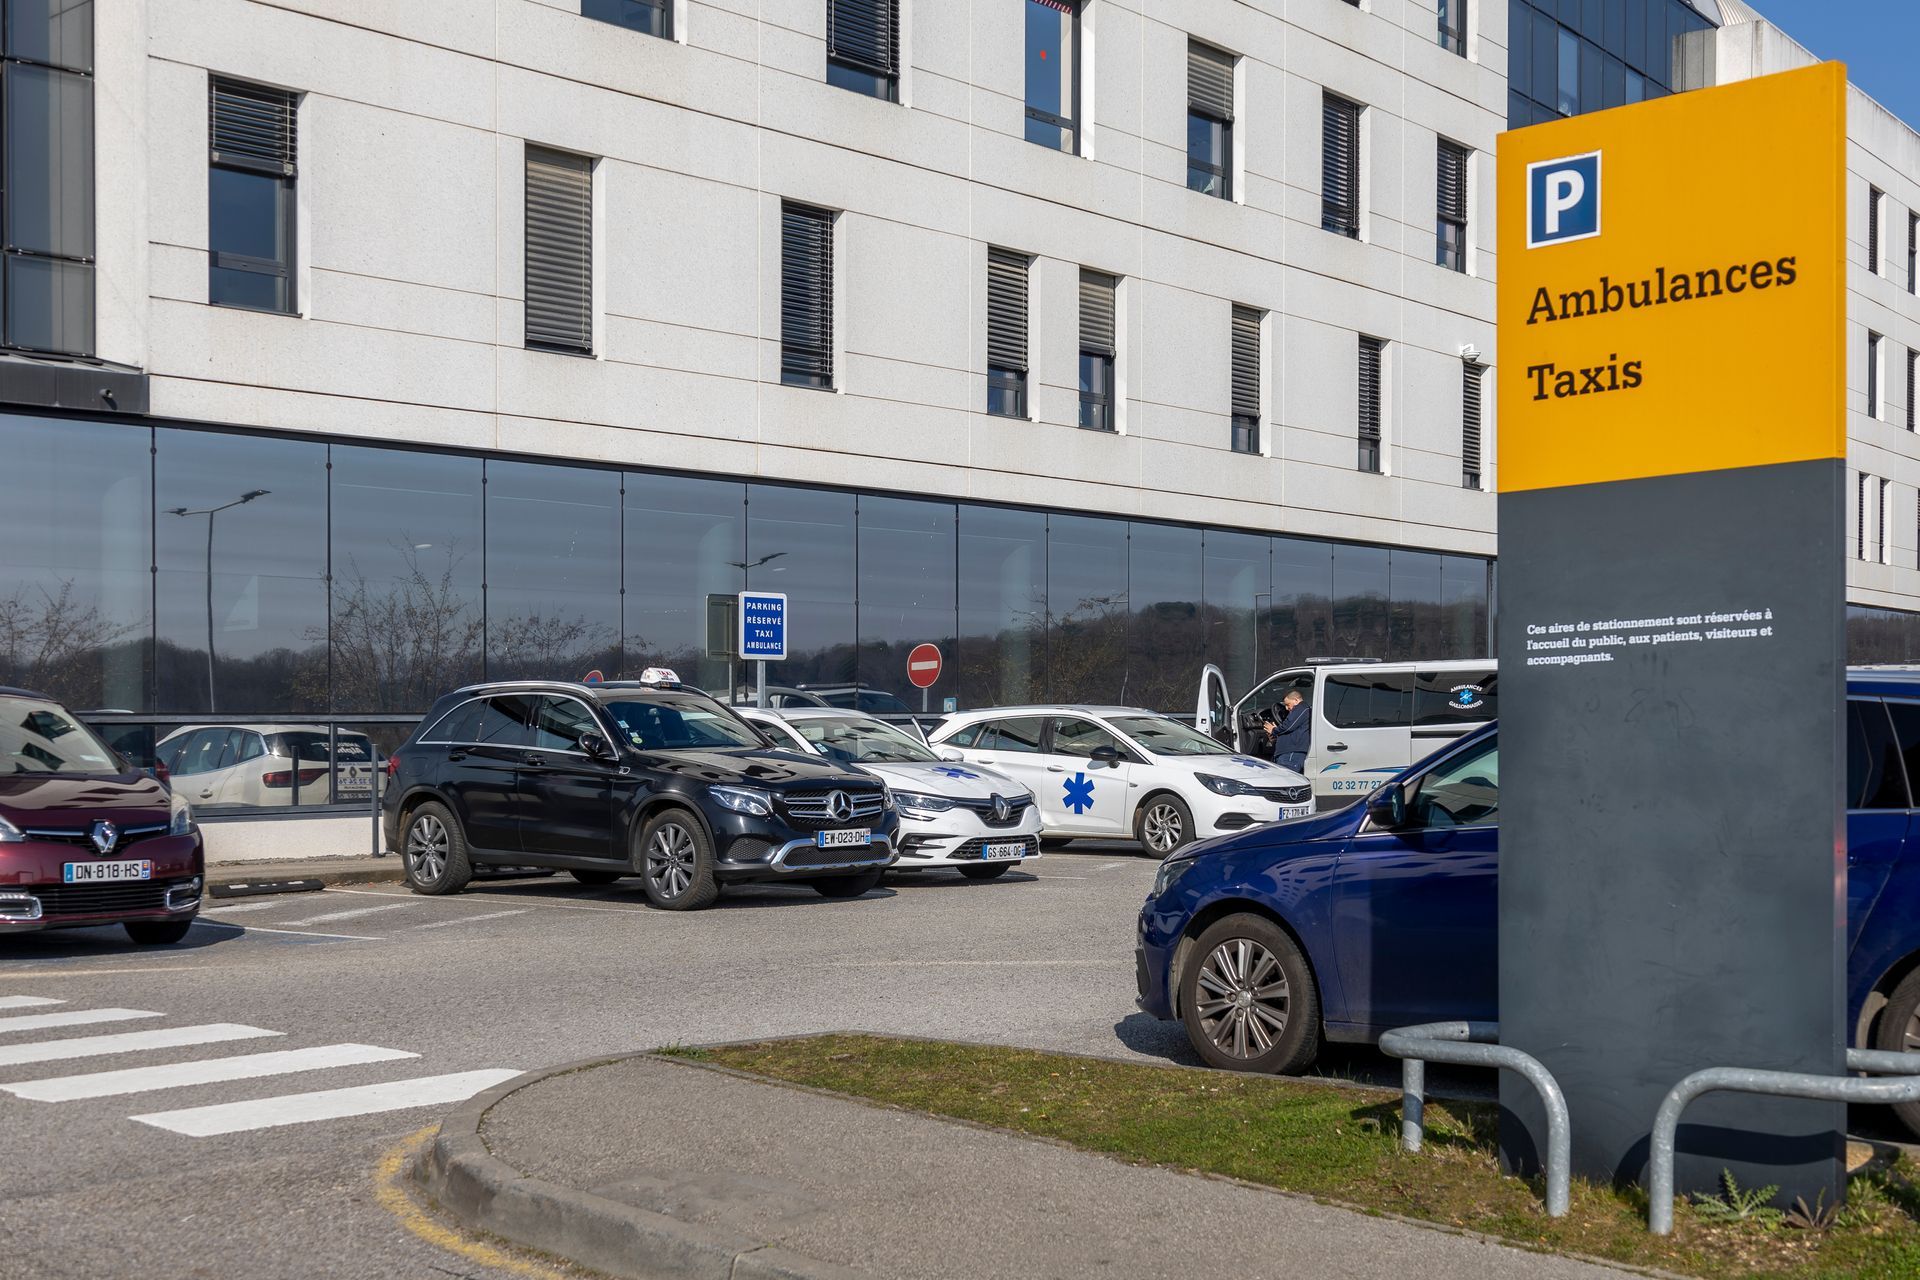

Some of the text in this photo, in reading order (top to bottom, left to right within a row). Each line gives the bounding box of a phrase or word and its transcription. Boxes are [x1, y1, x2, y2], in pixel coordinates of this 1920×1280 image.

[1545, 169, 1585, 235] P
[1526, 256, 1797, 325] Ambulances
[1527, 353, 1643, 401] Taxis
[746, 602, 782, 611] PARKING
[1526, 608, 1773, 635] Ces aires de stationnement sont réservées à
[755, 629, 773, 637] TAXI
[1526, 626, 1773, 650] l'accueil du public, aux patients, visiteurs et
[746, 641, 782, 650] AMBULANCE
[1526, 652, 1614, 666] accompagnants.
[1450, 684, 1483, 693] AMBULANCES
[1332, 780, 1343, 790] 02
[1345, 780, 1356, 790] 32
[1359, 780, 1369, 790] 77
[824, 830, 865, 844] EW-023-DH
[76, 863, 140, 879] DN-818-HS
